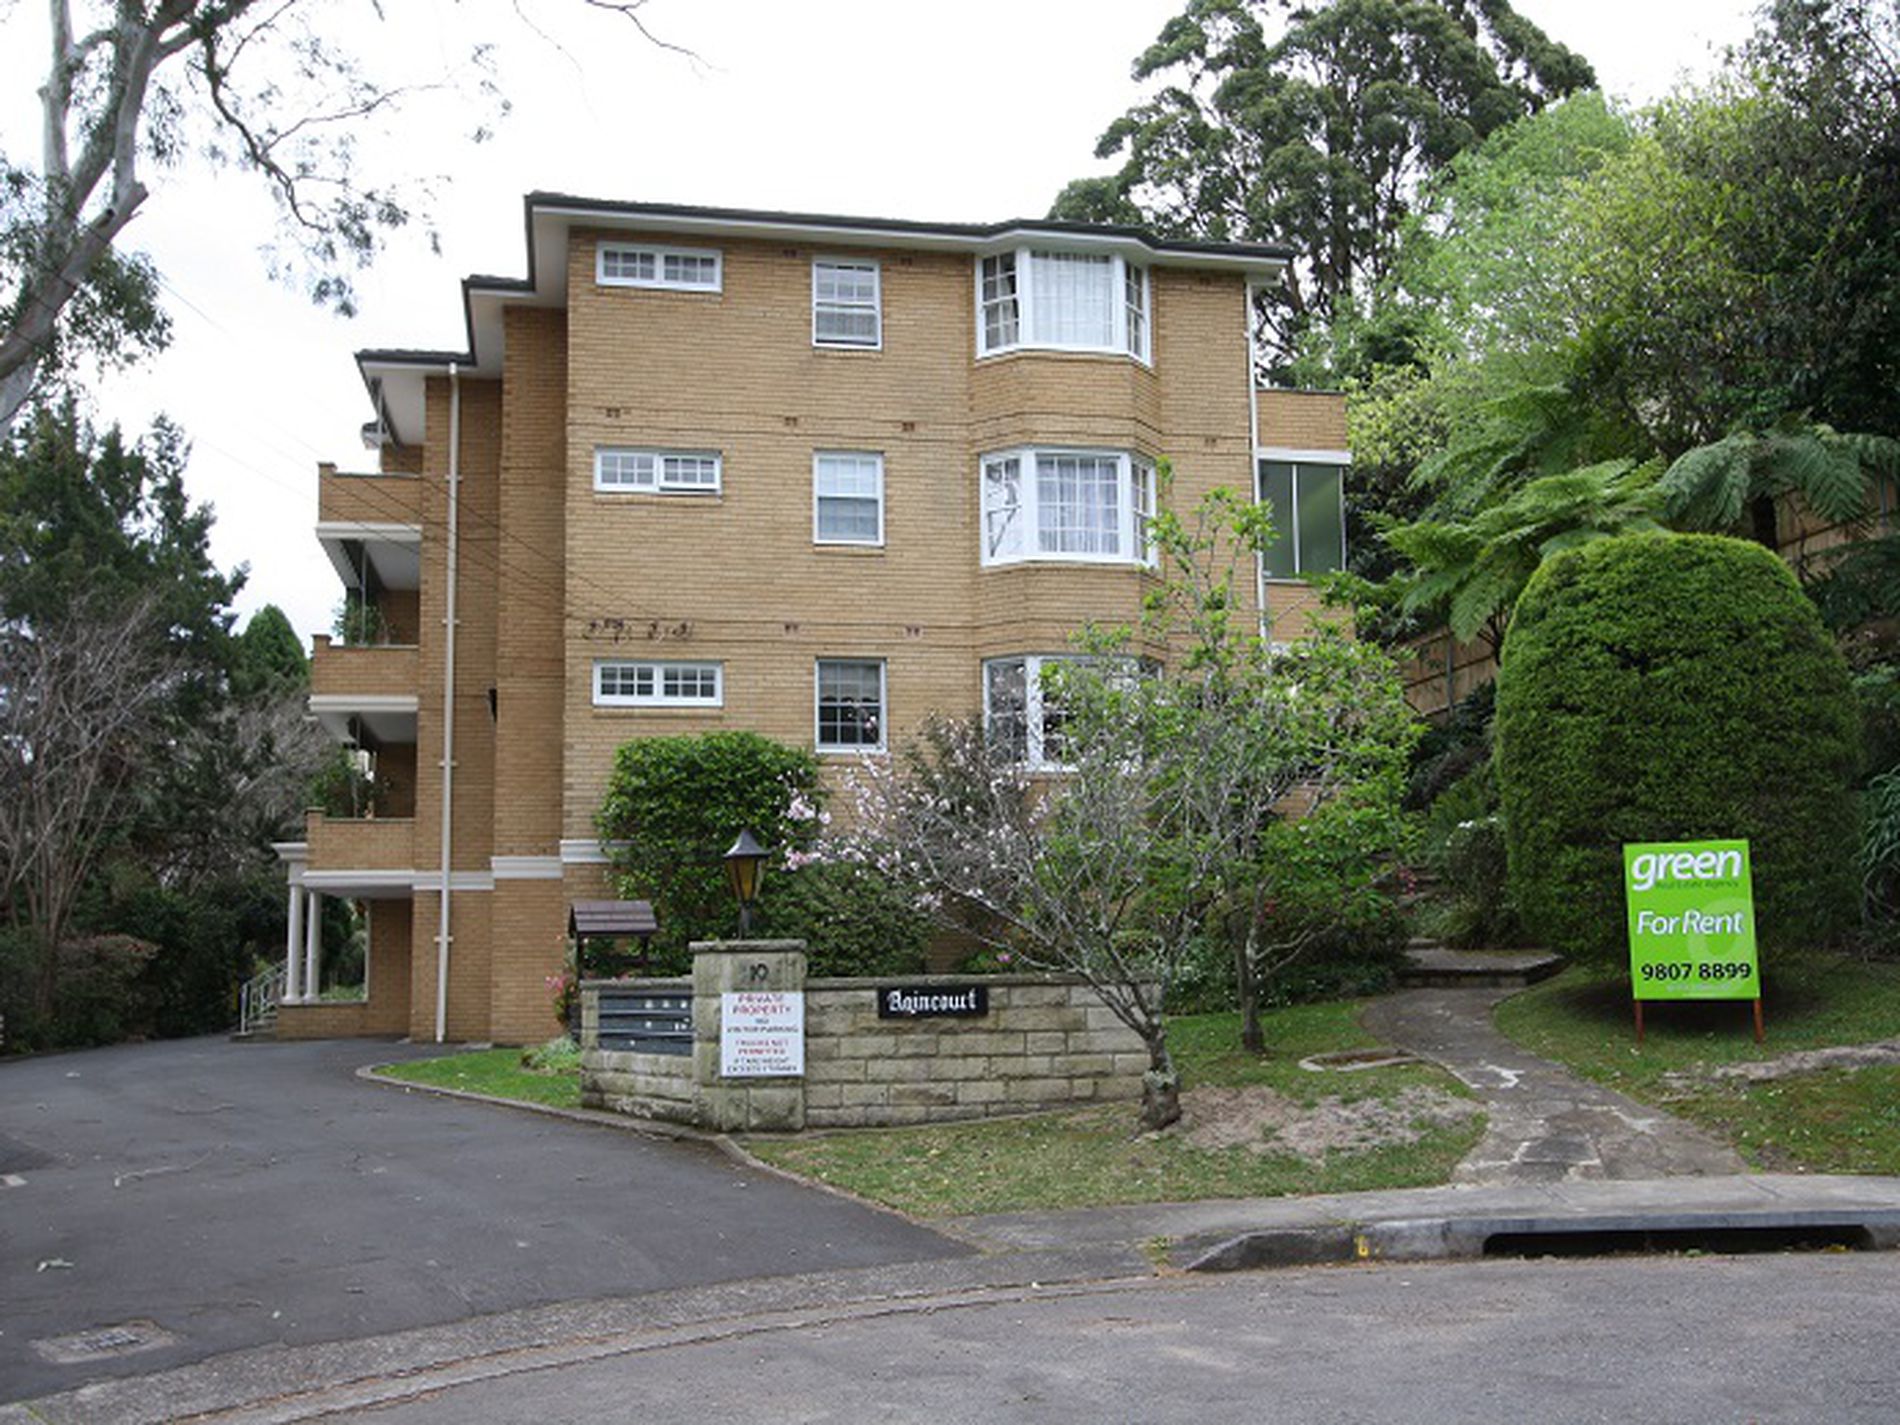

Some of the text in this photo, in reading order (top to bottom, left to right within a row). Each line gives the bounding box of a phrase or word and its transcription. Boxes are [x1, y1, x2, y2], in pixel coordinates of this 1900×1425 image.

[1631, 850, 1742, 891] green
[1637, 910, 1744, 935] For Rent
[1641, 962, 1752, 981] 9807 8899
[733, 1005, 791, 1014] PROPERTY
